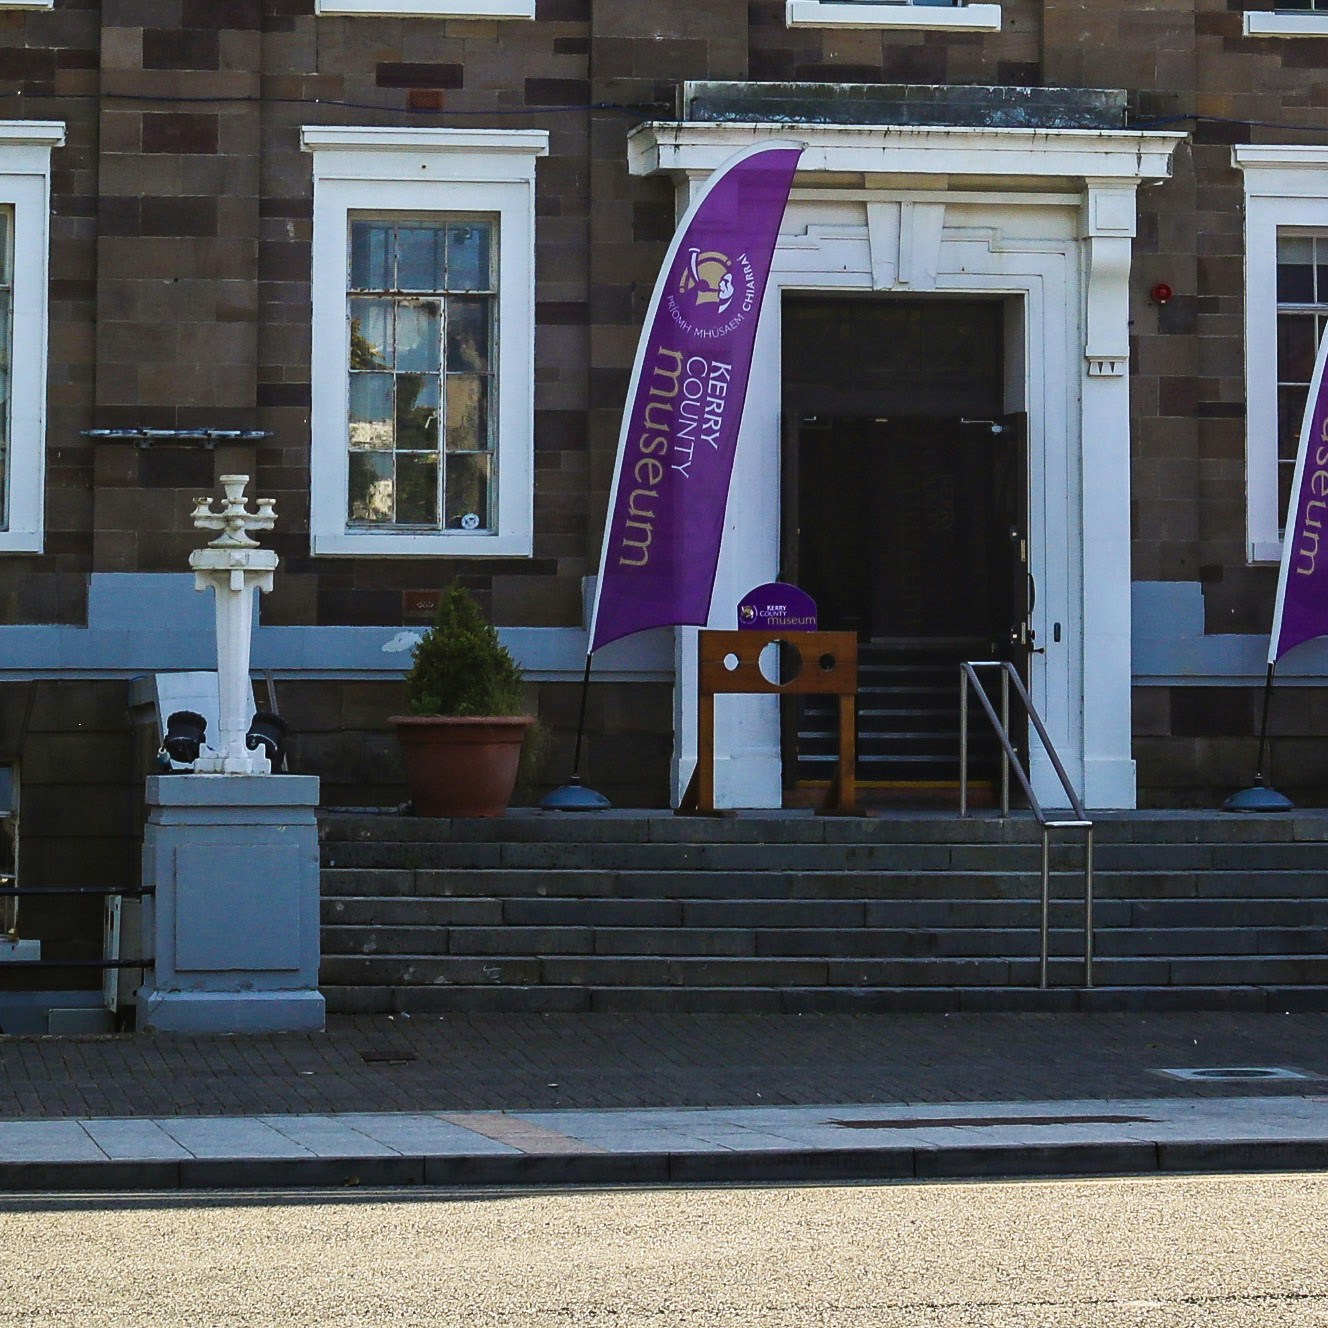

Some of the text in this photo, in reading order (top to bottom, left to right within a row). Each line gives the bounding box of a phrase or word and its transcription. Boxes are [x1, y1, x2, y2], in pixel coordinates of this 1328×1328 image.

[667, 253, 756, 339] PRÍOMH MHÚSAEM CHIARRAÍ
[671, 356, 708, 478] COUNTY
[701, 360, 732, 450] KERRY
[619, 345, 684, 567] museum
[767, 616, 816, 625] museum
